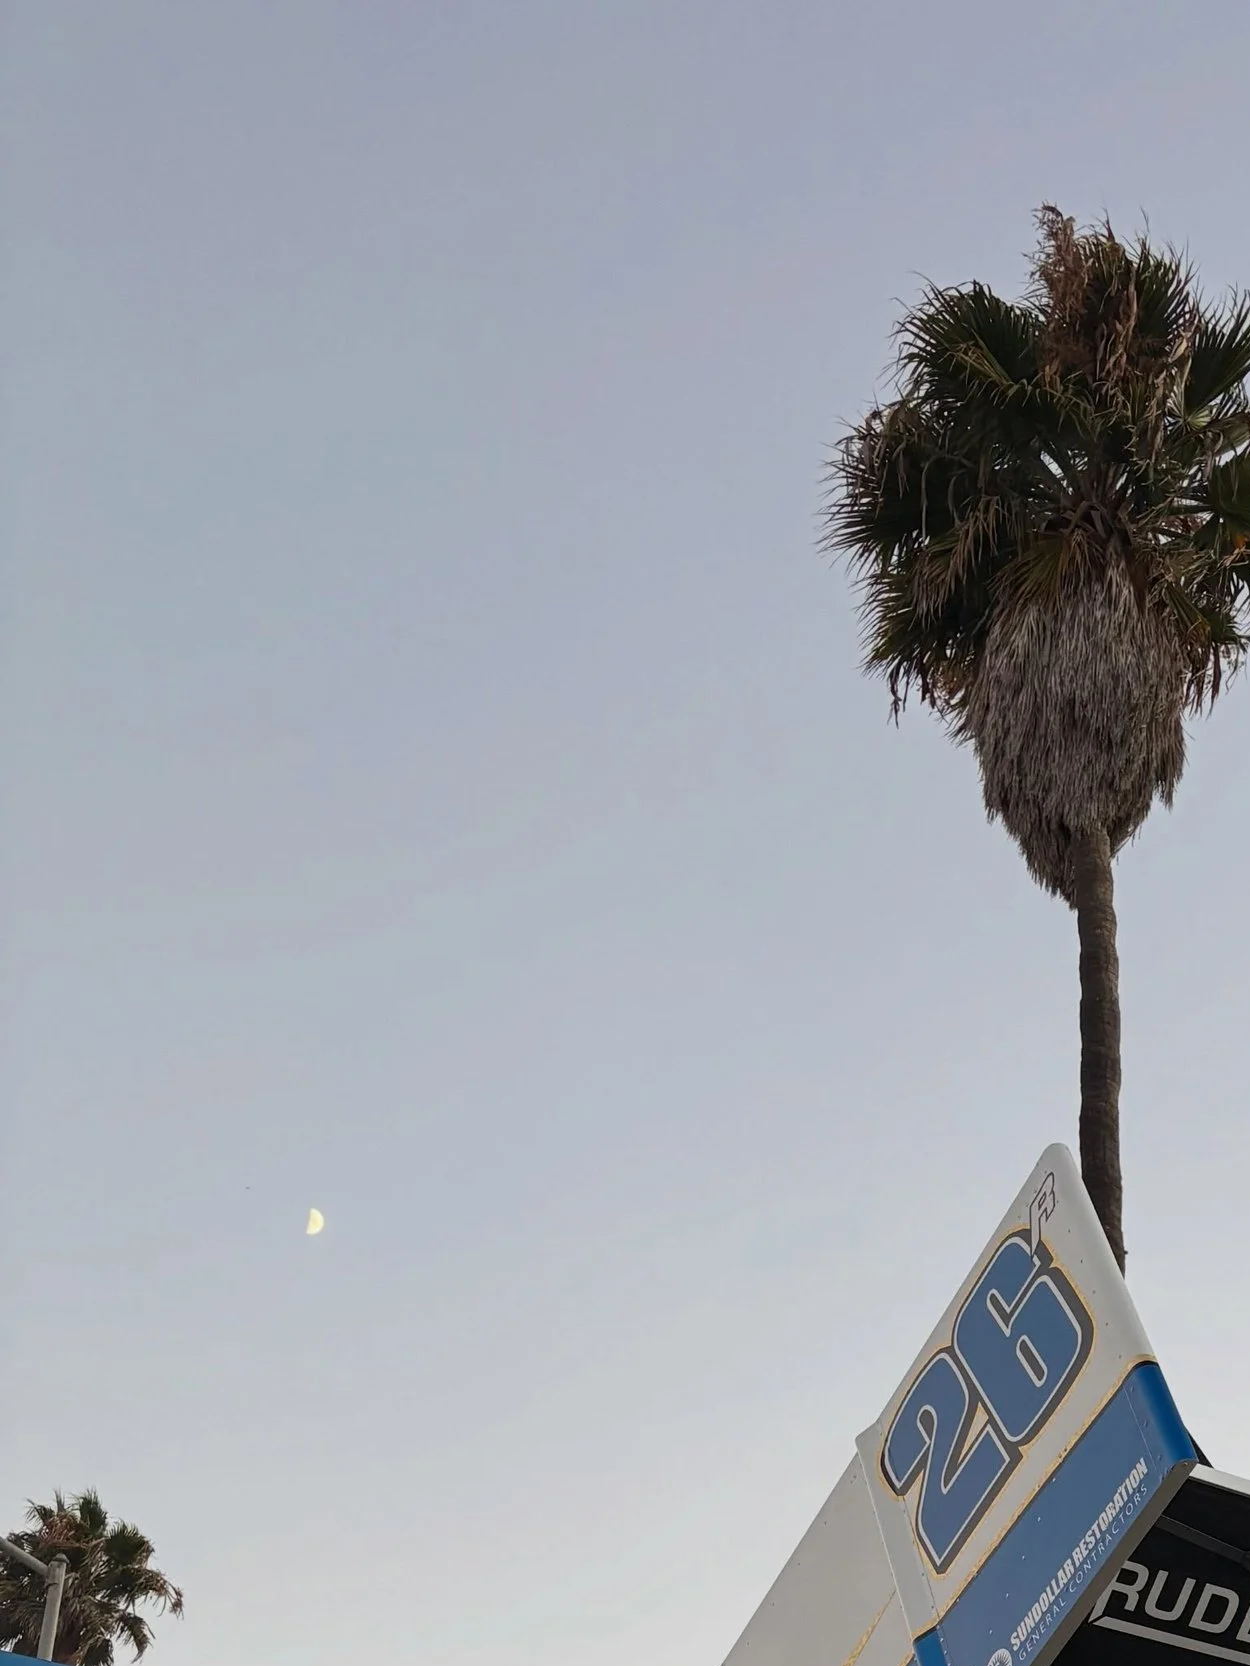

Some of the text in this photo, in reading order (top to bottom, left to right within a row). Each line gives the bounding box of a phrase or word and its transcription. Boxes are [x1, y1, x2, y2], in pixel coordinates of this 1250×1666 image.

[880, 1228, 1094, 1576] 26
[1010, 1457, 1149, 1651] SUNDOLLAR RESTORATION
[1019, 1483, 1149, 1661] GENERAL CONTRACTORS
